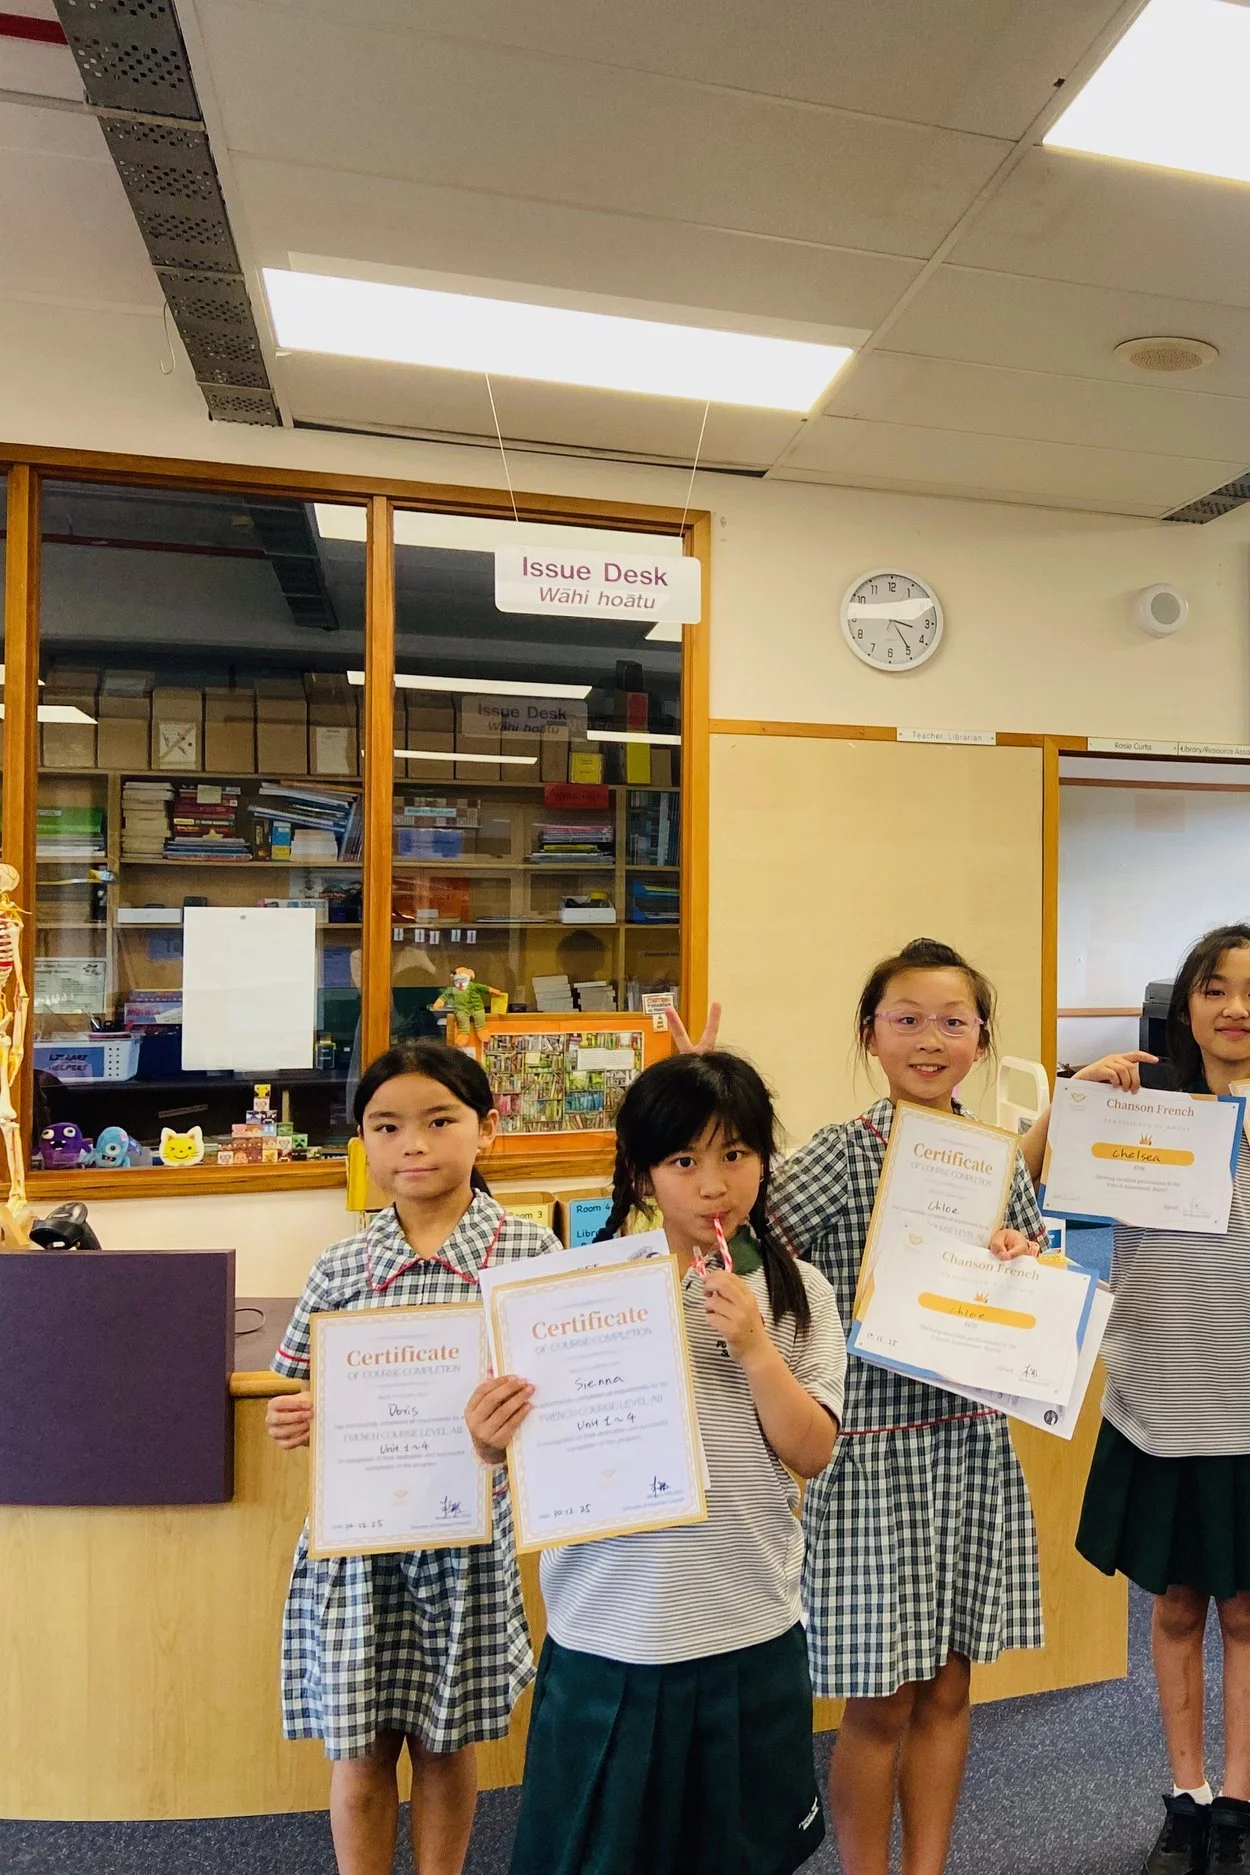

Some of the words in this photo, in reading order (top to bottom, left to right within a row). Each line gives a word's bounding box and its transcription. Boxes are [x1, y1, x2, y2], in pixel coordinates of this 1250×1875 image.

[522, 556, 591, 580] Issue
[604, 562, 668, 586] Desk
[871, 585, 878, 595] 11
[887, 582, 897, 592] 12
[907, 588, 911, 598] 1
[539, 586, 589, 604] Wāhi
[598, 591, 656, 609] hoātu
[924, 619, 930, 629] 3
[857, 629, 863, 639] 8
[919, 634, 924, 643] 4
[870, 643, 876, 653] 7
[887, 648, 893, 658] 6
[905, 646, 911, 655] 5
[478, 703, 519, 718] Issue
[527, 706, 567, 720] Desk
[912, 730, 943, 739] Teacher
[948, 732, 982, 742] Librarian
[1114, 742, 1132, 750] Rosie
[1106, 1098, 1154, 1114] Chanson
[1156, 1105, 1195, 1118] French
[913, 1142, 993, 1175] Certificate
[576, 1204, 601, 1213] Room
[928, 1200, 960, 1215] Chloe
[942, 1251, 995, 1273] Chanson
[997, 1262, 1040, 1281] French
[532, 1306, 648, 1340] Certificate
[346, 1344, 460, 1367] Certificate
[574, 1375, 624, 1391] Sienna
[388, 1403, 418, 1417] Doris
